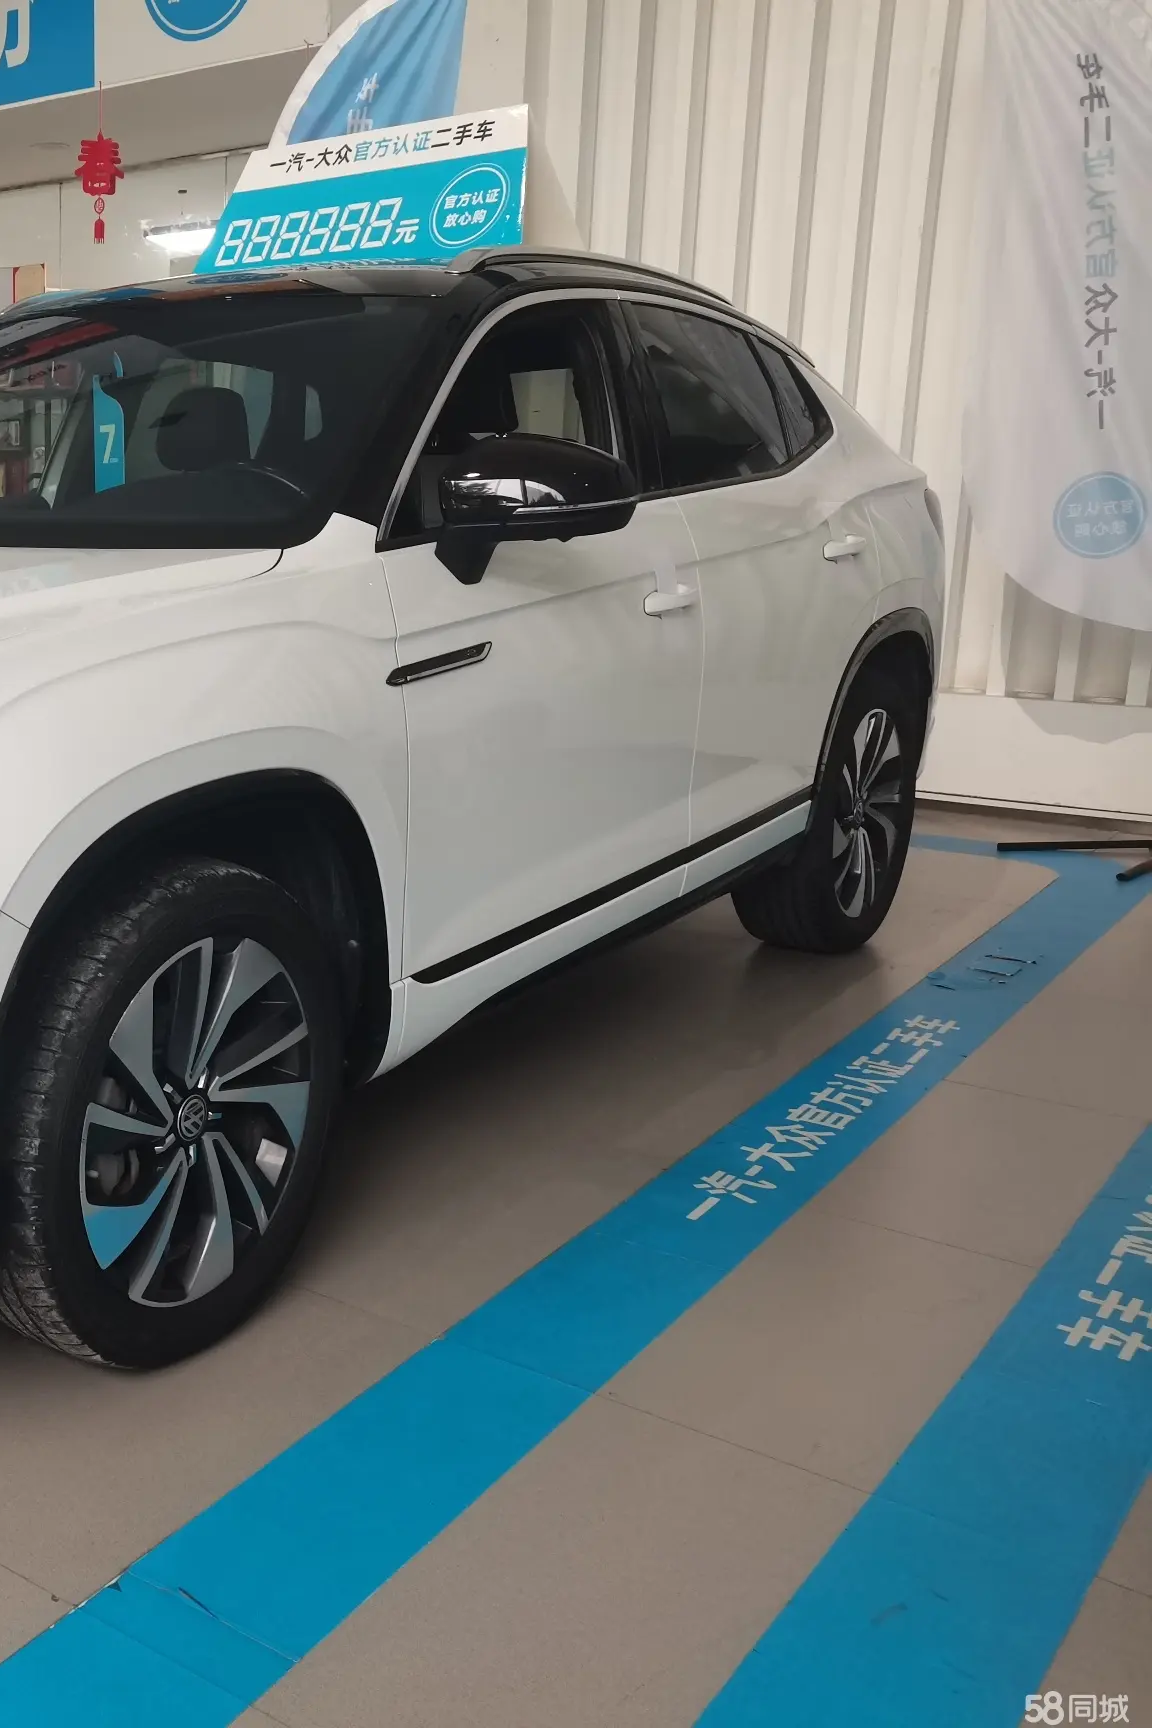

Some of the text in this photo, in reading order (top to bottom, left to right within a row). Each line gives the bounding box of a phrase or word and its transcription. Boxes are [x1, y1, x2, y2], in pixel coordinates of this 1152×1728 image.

[270, 120, 497, 173] 一汽-大众官方认证二手车
[443, 187, 500, 210] 官方认证
[443, 209, 487, 228] 放心购
[99, 424, 116, 464] 7
[686, 1014, 961, 1221] 一汽-大众官方认证二手车
